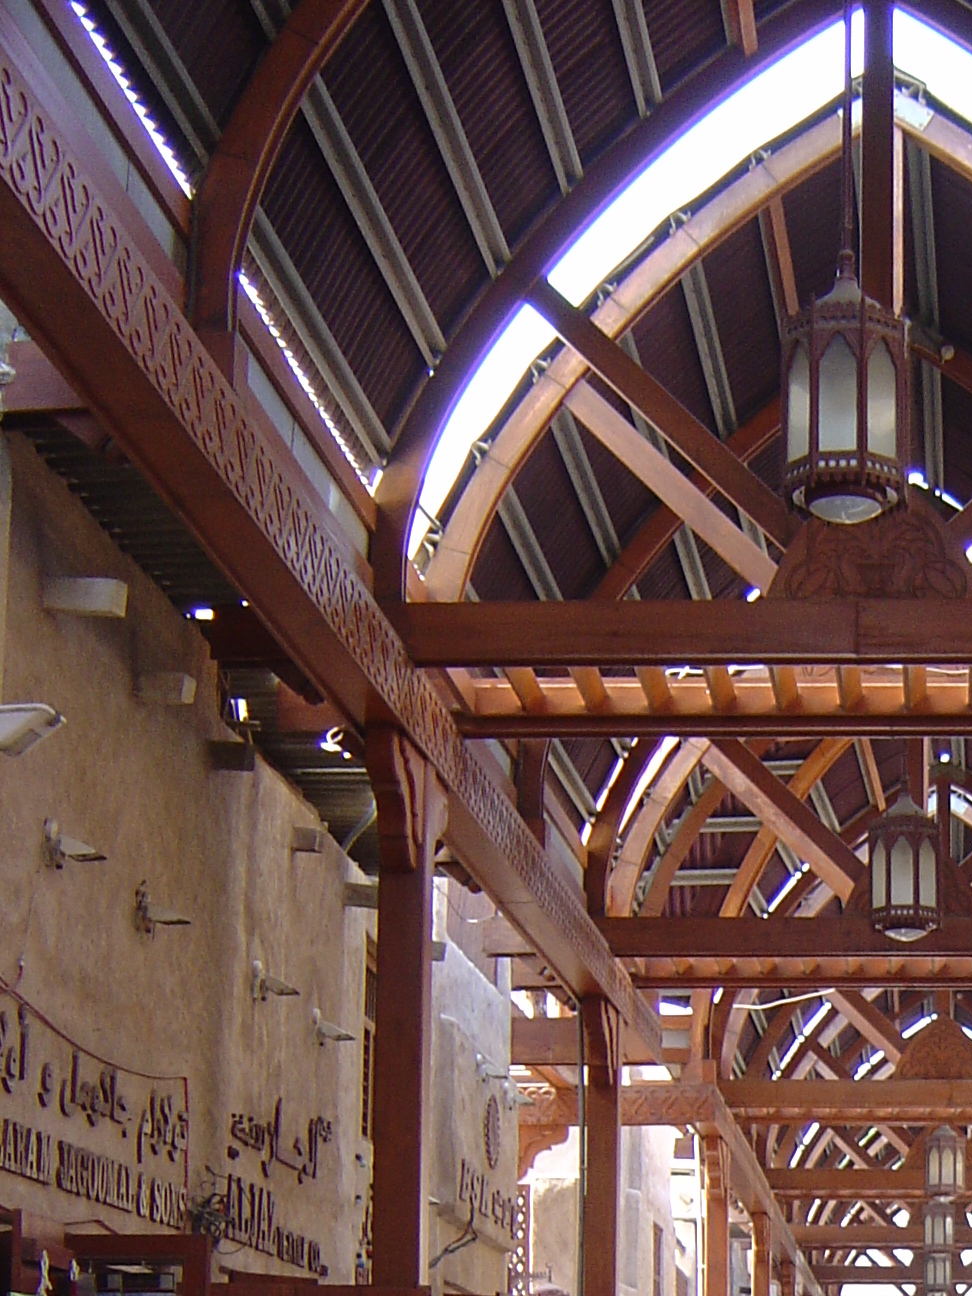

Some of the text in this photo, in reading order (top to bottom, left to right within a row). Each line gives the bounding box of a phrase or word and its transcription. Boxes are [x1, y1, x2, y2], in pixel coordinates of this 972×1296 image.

[0, 1117, 51, 1187] ARAM
[136, 1171, 149, 1218] &
[150, 1177, 187, 1231] SONS
